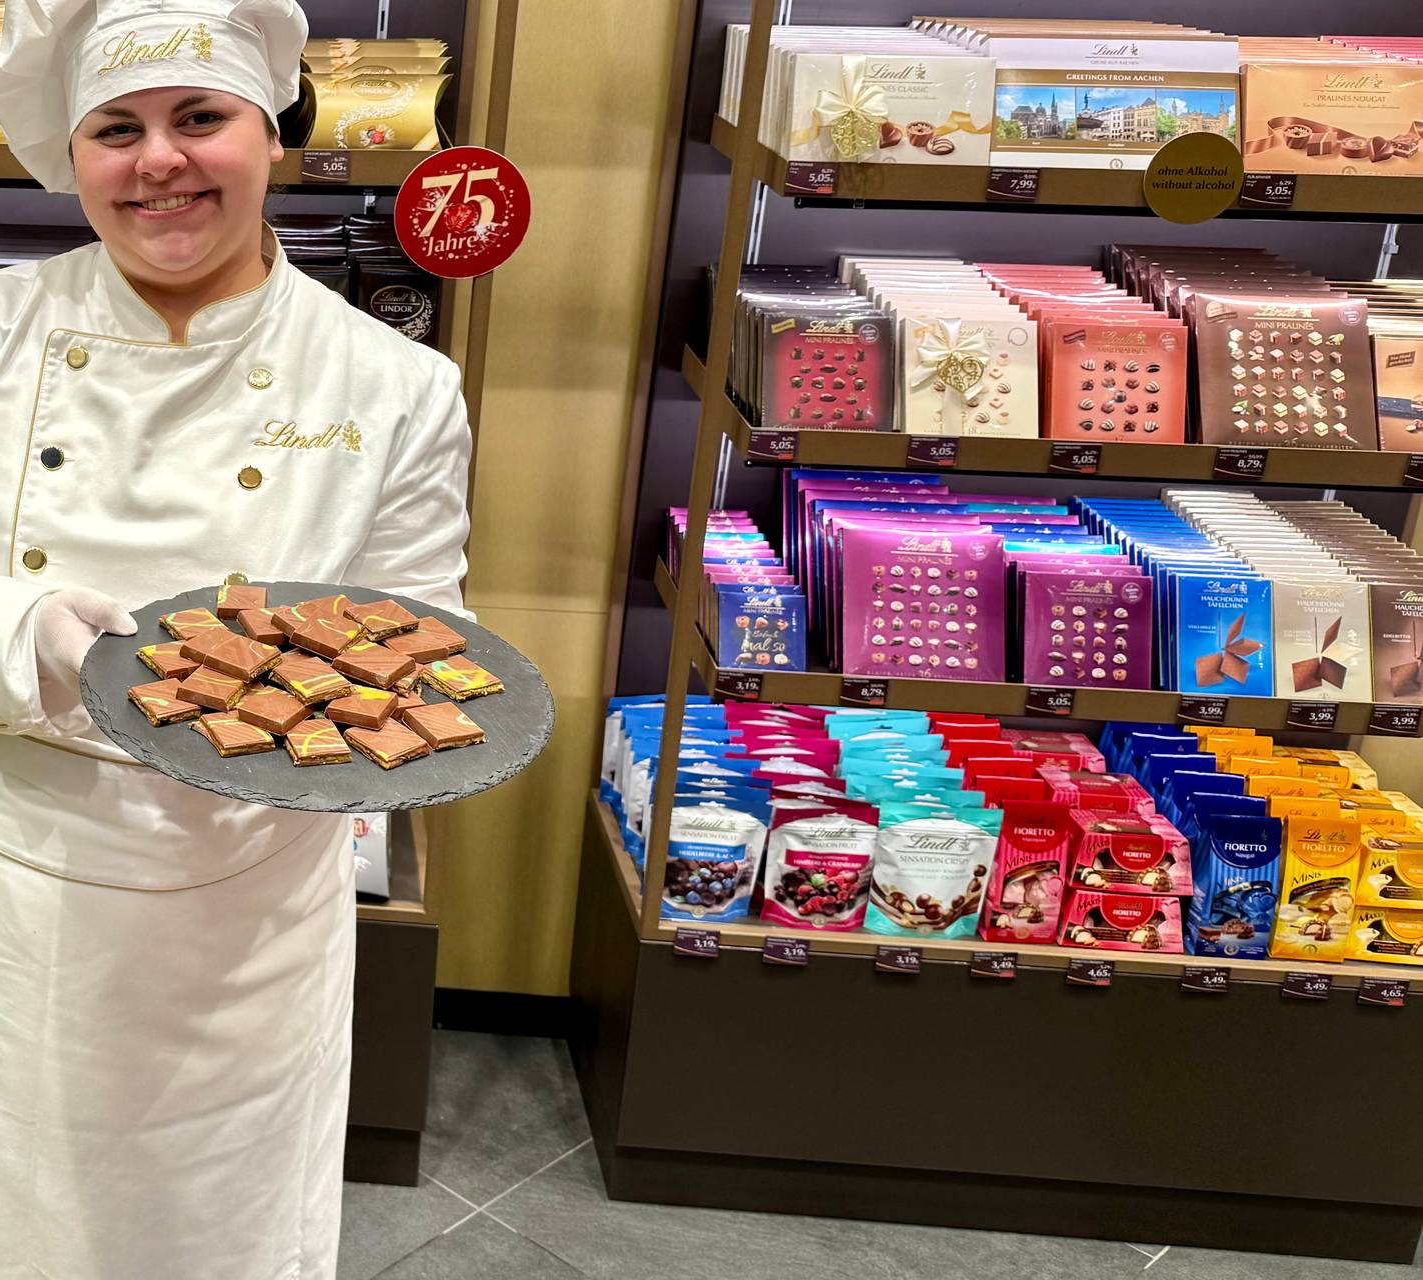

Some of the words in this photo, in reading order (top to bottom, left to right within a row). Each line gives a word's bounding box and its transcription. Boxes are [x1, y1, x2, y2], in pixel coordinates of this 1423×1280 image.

[98, 28, 185, 76] Lindt
[1091, 43, 1128, 56] Lindt
[865, 63, 914, 79] Lindt
[1066, 73, 1108, 81] GREETINGS
[1133, 74, 1164, 82] AACHEN
[1322, 72, 1371, 88] Lindt
[1317, 94, 1352, 102] PRALINÉS
[1157, 166, 1184, 176] ohne
[1186, 166, 1228, 177] Alkohol
[1152, 180, 1194, 190] without
[1195, 180, 1235, 190] alcohol
[1265, 186, 1292, 196] 5,05€
[419, 167, 500, 239] 75
[426, 234, 478, 257] Jahre
[380, 305, 413, 313] LINDOR
[1254, 305, 1299, 317] Lindt
[805, 320, 843, 333] Lindt
[1255, 321, 1275, 329] MINI
[1277, 321, 1314, 331] PRALINÉS
[253, 420, 342, 450] Lindt
[897, 537, 940, 552] Lindt
[1201, 595, 1249, 603] HAUCHDÜNNE
[688, 816, 724, 828] Lindt
[680, 831, 714, 839] SENSATION
[810, 826, 846, 839] Lindt
[1014, 827, 1055, 837] FIORETTO
[802, 841, 838, 849] SENSATION
[904, 833, 958, 850] Lindt
[1224, 842, 1268, 853] FIORETTO
[1302, 844, 1346, 853] FIORETTO
[899, 855, 942, 864] SENSATION
[1123, 851, 1152, 859] FIORETTO
[1234, 852, 1256, 860] Nougat
[1291, 870, 1322, 886] MINIS
